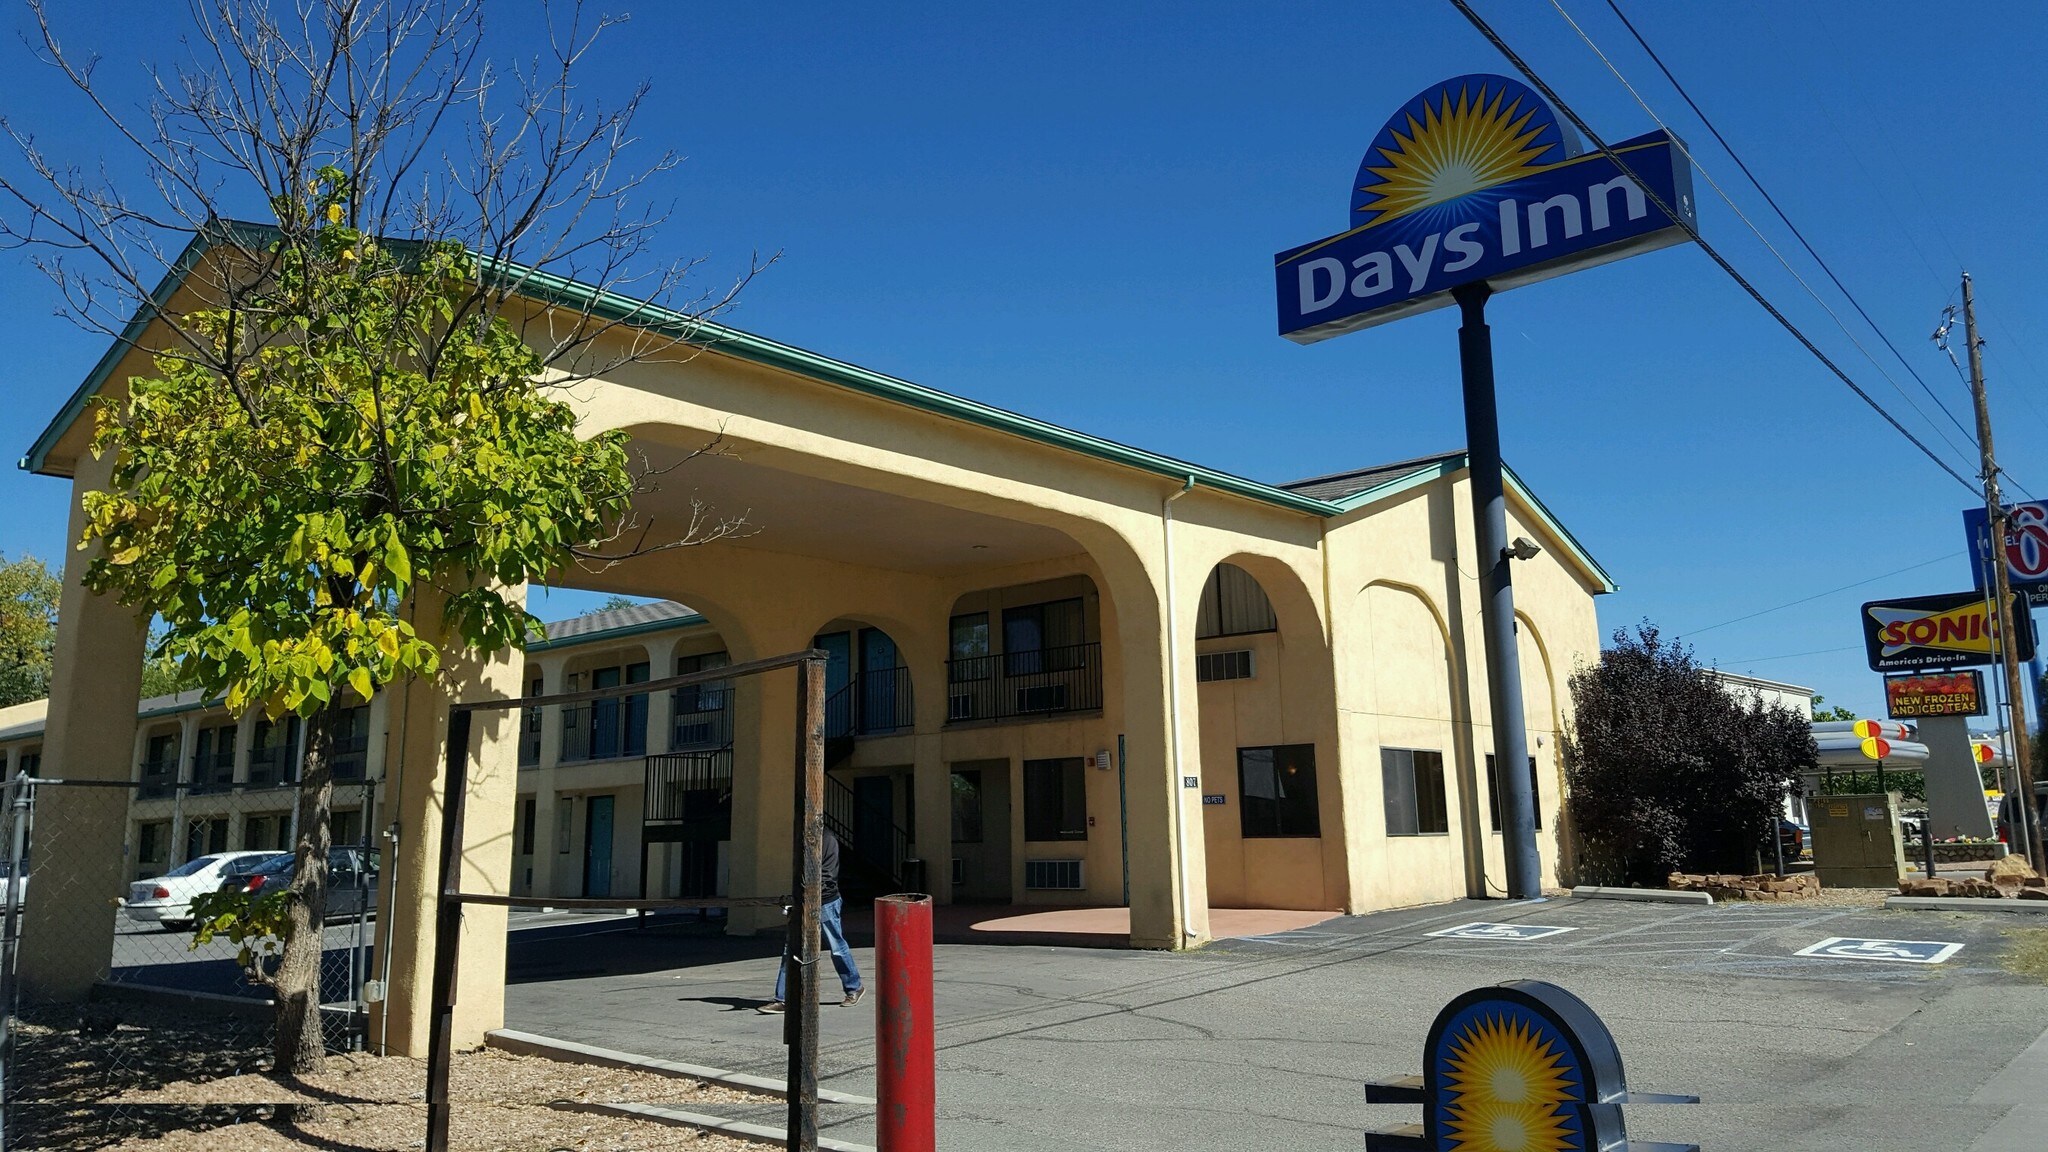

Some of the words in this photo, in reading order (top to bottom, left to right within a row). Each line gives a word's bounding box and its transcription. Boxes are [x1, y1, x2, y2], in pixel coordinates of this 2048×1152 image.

[1298, 222, 1485, 315] Days
[1499, 175, 1648, 257] Inn
[1976, 534, 2020, 551] MEL
[2004, 504, 2048, 577] 6
[1878, 656, 1924, 667] America's
[1925, 654, 1967, 664] Drive-In
[1895, 696, 1920, 706] NEW
[1924, 693, 1970, 704] FROZEN
[1891, 705, 1915, 715] AND
[1918, 704, 1944, 714] ICED
[1946, 701, 1977, 712] TEAS
[1203, 796, 1211, 804] NO
[1211, 796, 1224, 804] PETS
